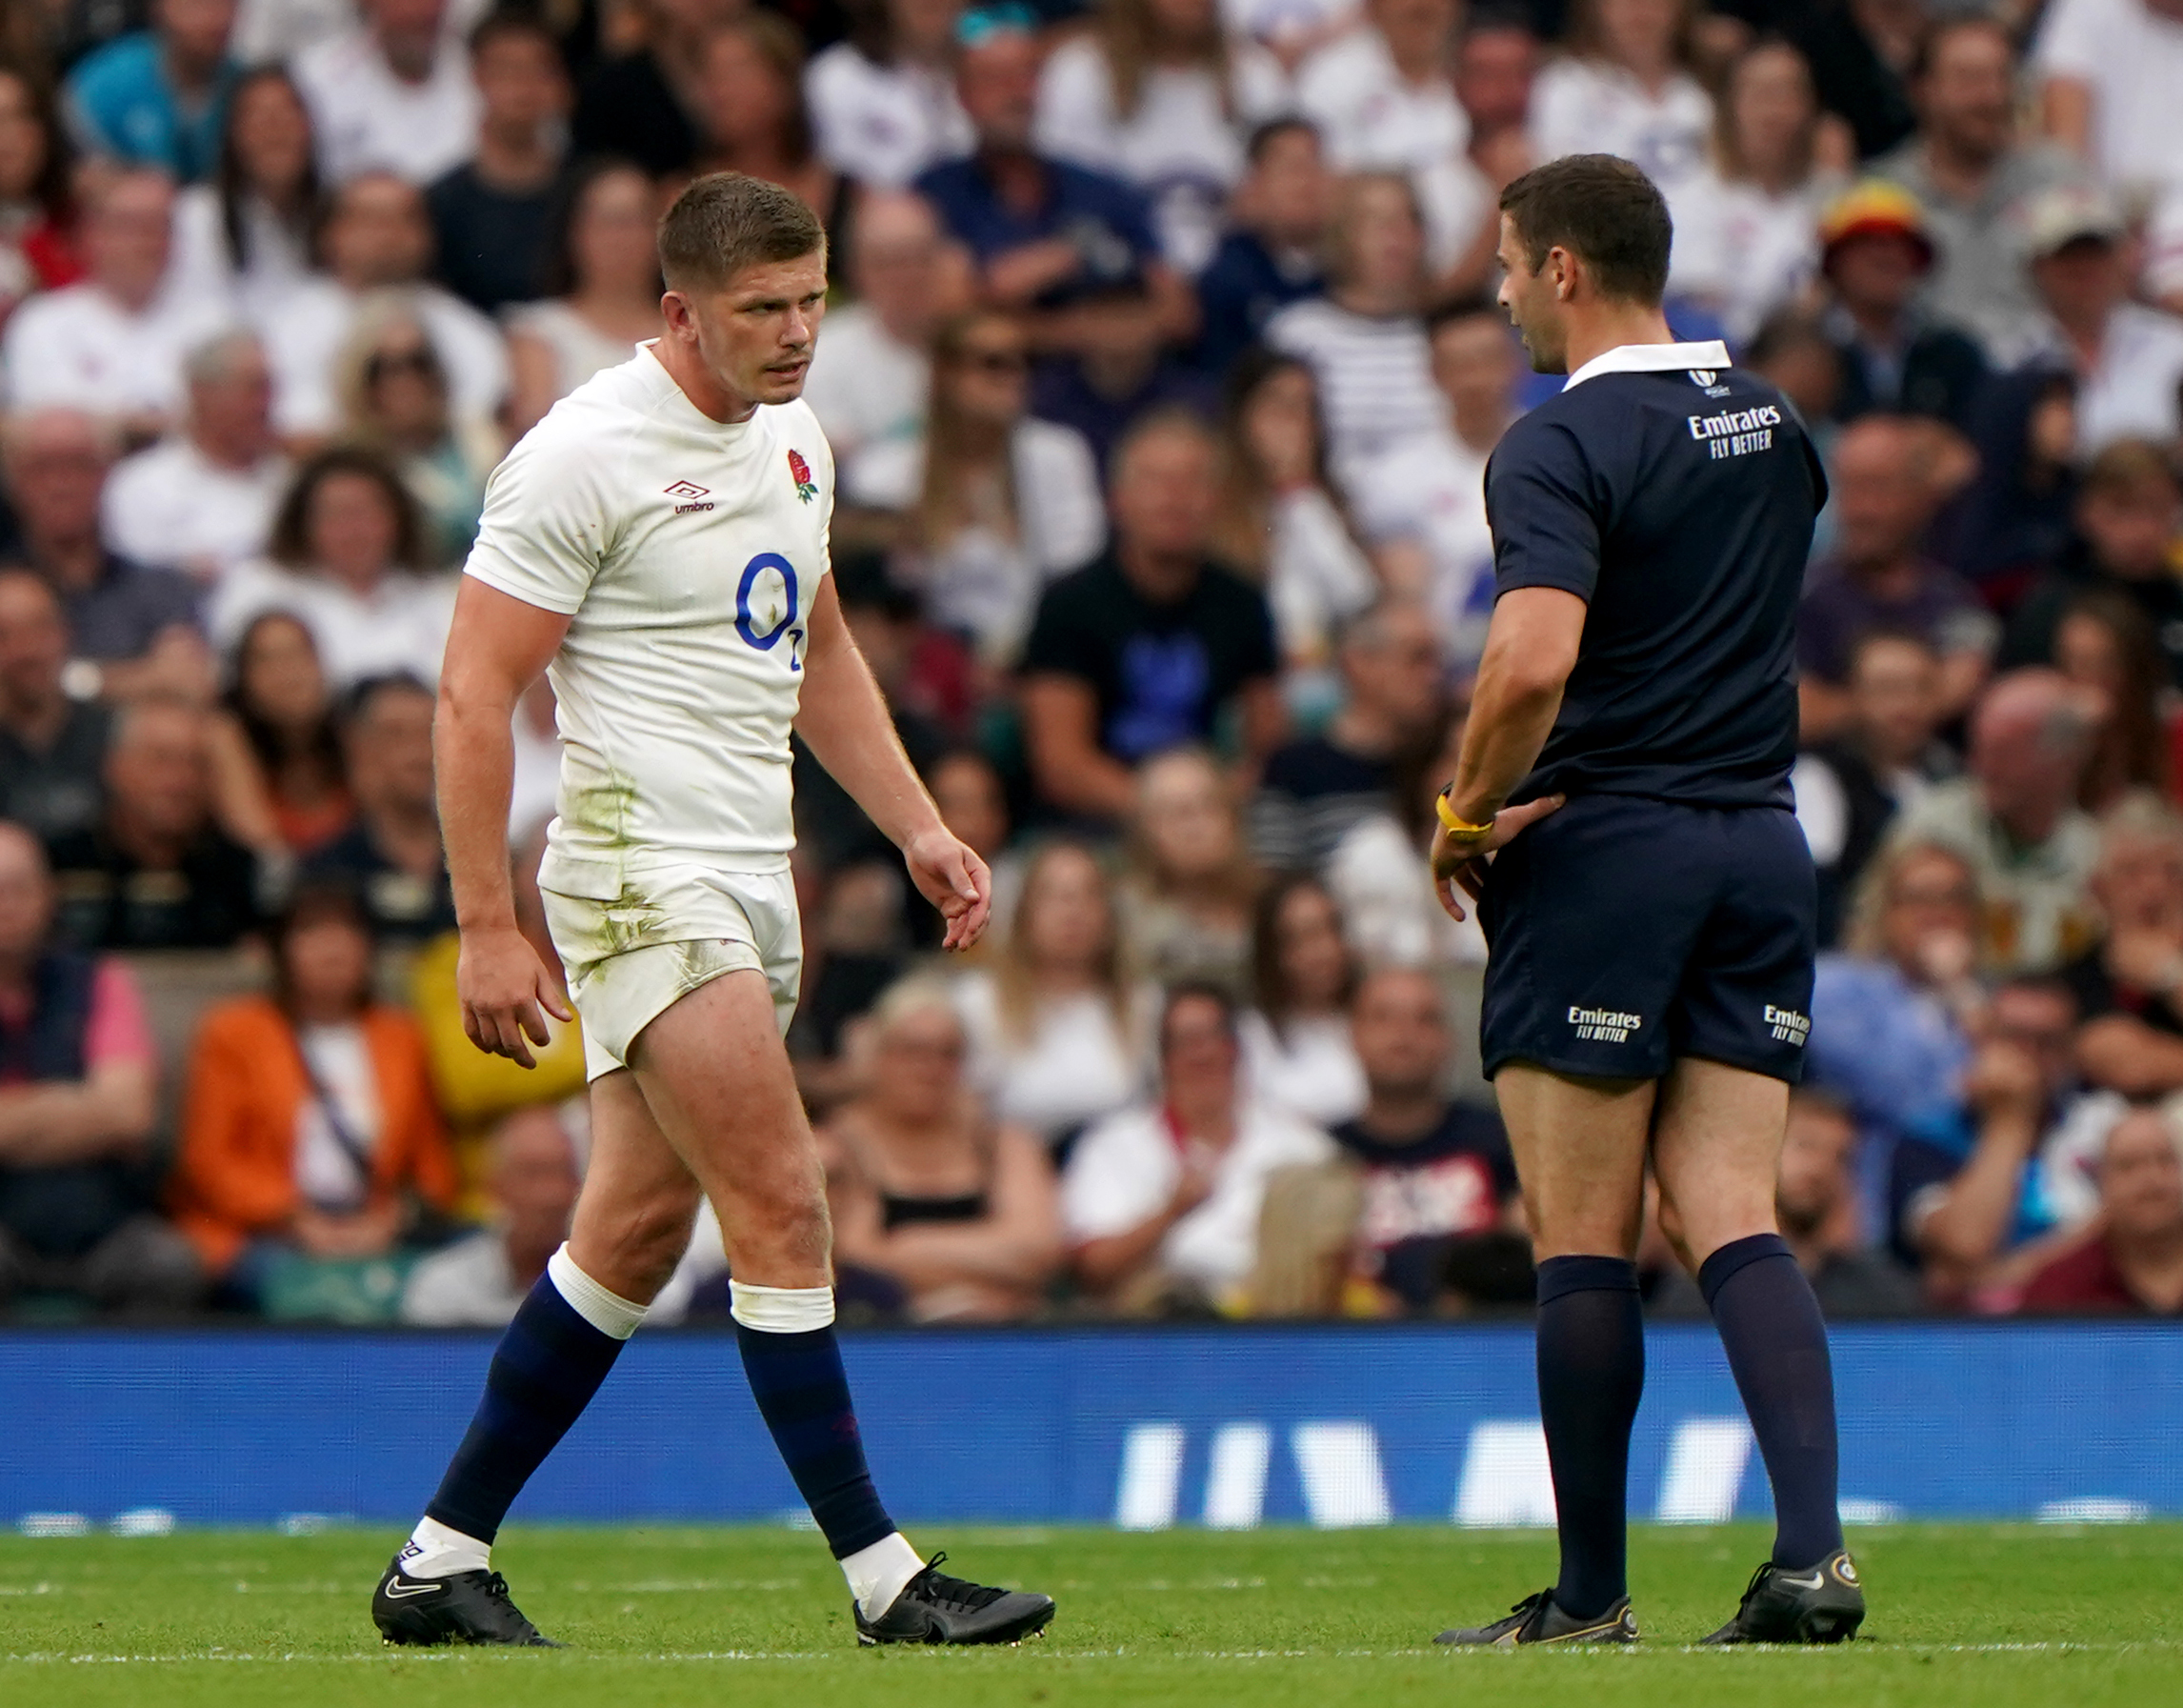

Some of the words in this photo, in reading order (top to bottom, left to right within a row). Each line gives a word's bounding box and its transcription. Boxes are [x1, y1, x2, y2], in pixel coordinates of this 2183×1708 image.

[1688, 405, 1781, 439] Emirates
[1710, 438, 1729, 459] FLY
[1732, 429, 1772, 455] BETTER
[675, 501, 714, 514] umbro
[1568, 1006, 1641, 1030] Emirates
[1576, 1025, 1594, 1039] FLY
